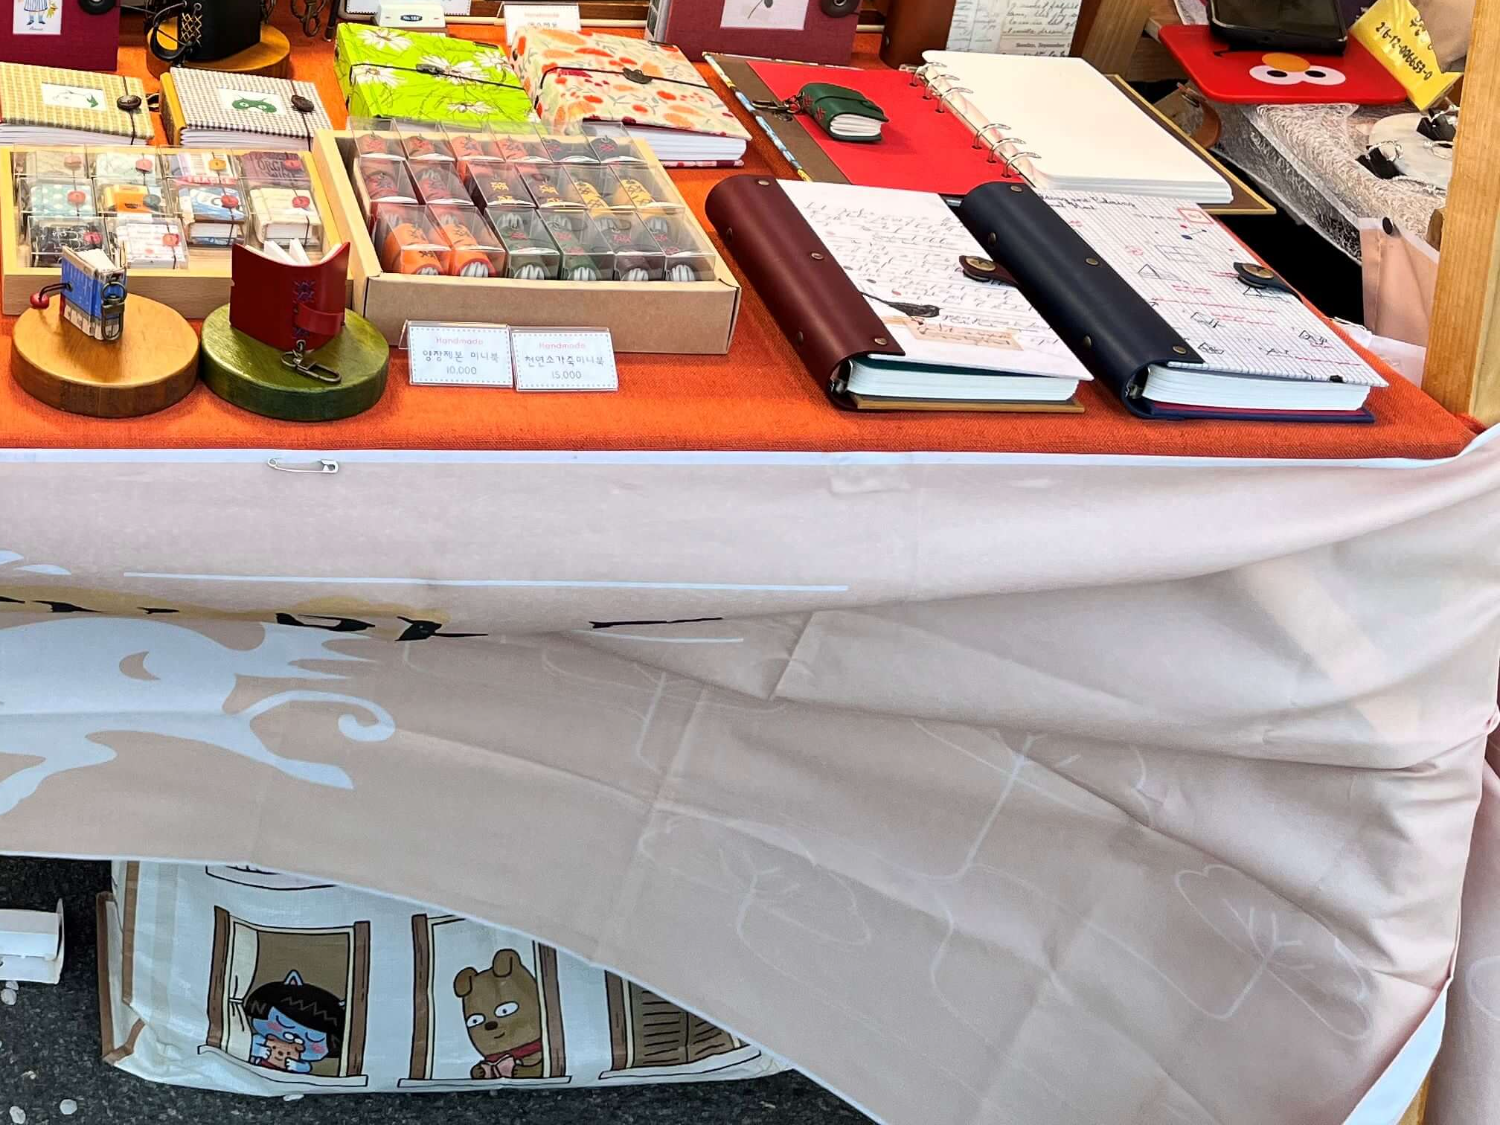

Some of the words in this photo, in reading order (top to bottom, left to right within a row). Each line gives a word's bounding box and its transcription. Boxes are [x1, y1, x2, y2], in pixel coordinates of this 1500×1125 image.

[436, 336, 484, 345] Handmade
[539, 341, 586, 350] Handmade
[470, 351, 500, 364] 미니북
[446, 365, 478, 376] 10,000
[551, 370, 583, 381] 15,000
